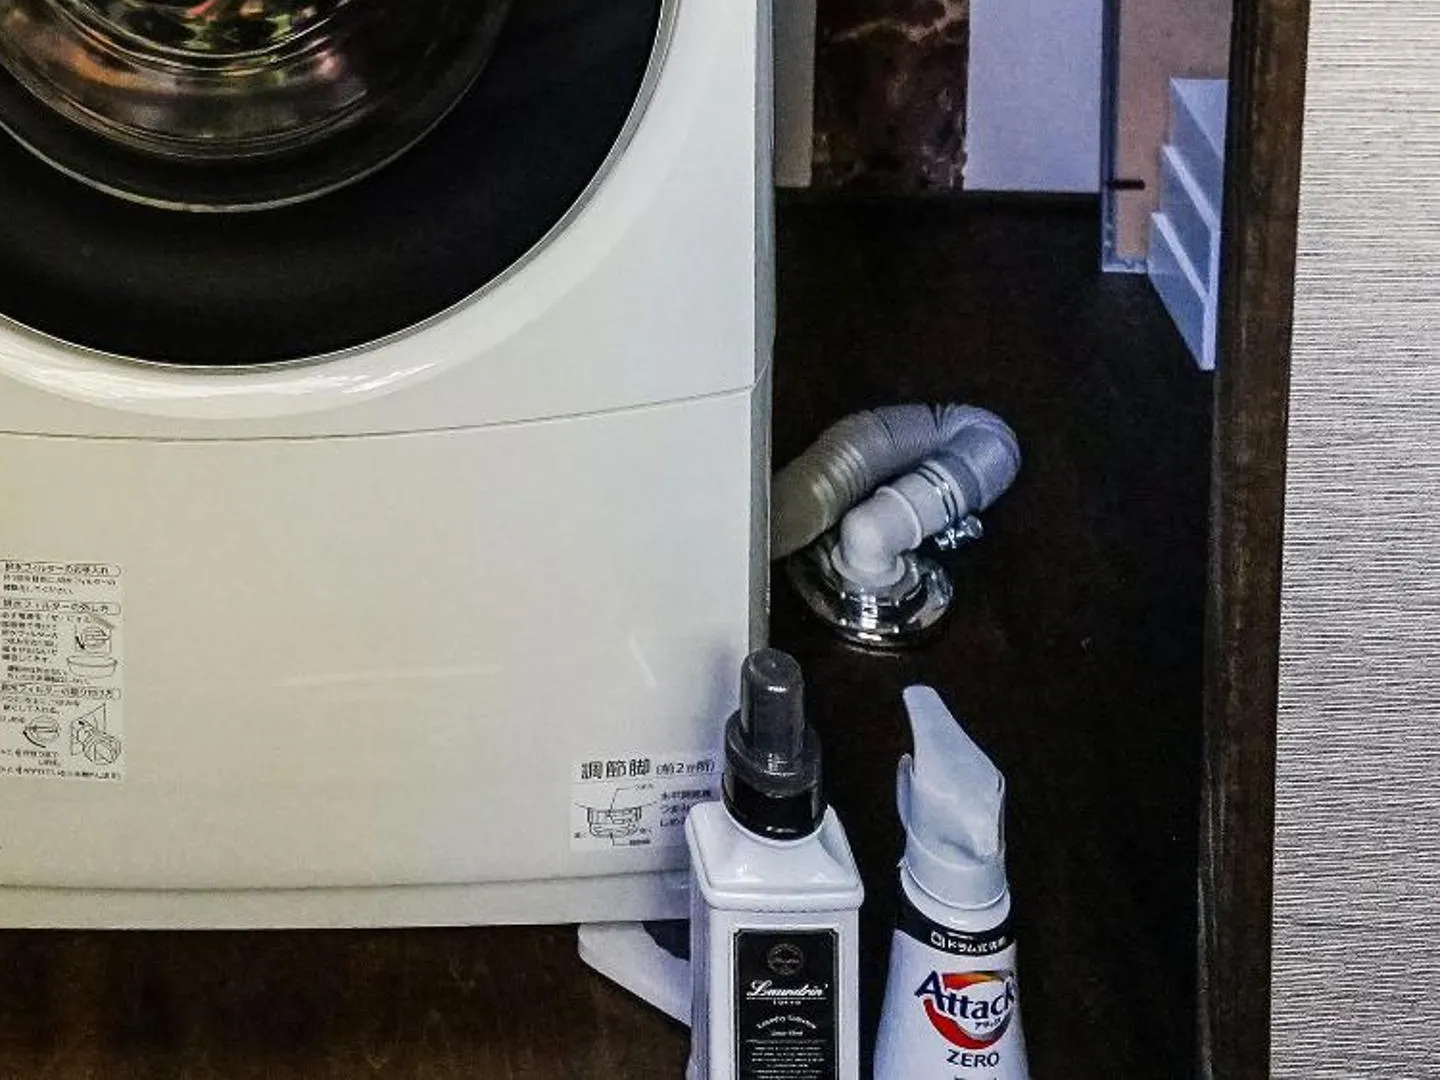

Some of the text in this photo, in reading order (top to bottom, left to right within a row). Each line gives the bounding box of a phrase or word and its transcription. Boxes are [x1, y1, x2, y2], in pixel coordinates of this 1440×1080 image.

[580, 758, 651, 780] 調節脚
[914, 970, 1015, 1019] Attack
[946, 1049, 1000, 1068] ZERO
